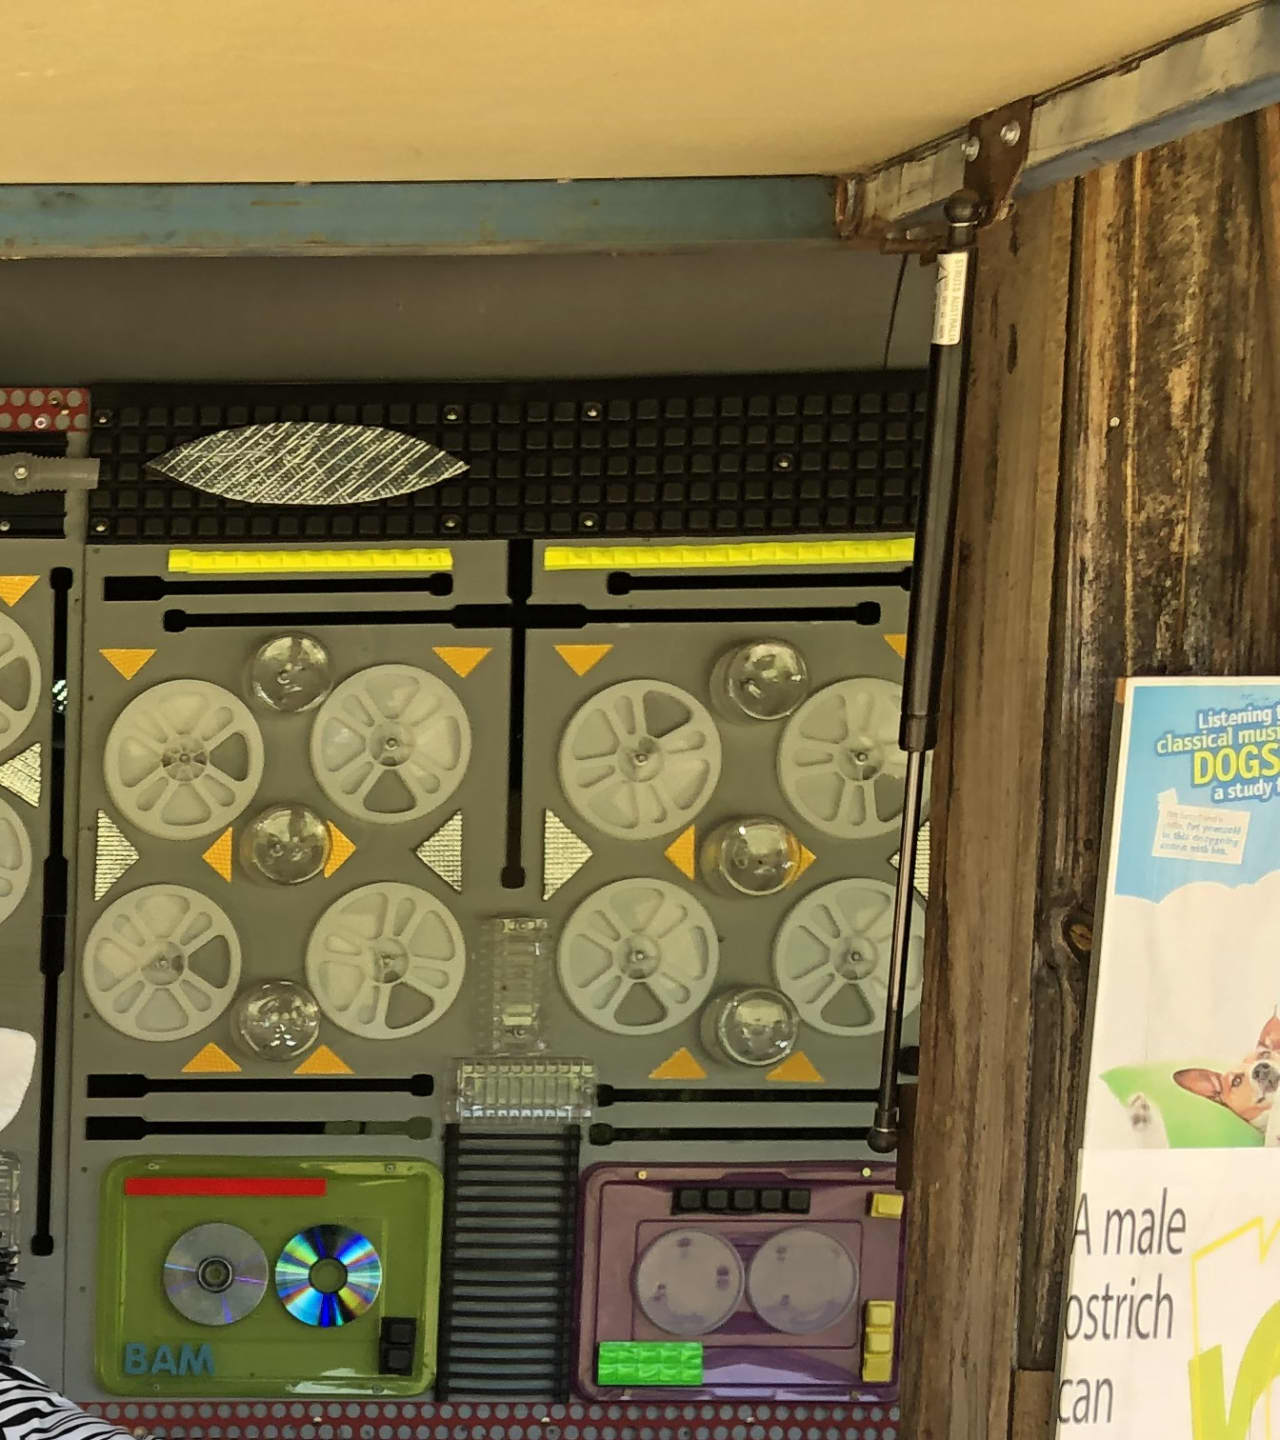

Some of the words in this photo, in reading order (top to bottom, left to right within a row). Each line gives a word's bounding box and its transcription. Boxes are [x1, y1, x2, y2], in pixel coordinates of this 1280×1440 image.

[1198, 706, 1272, 729] Listening
[1157, 727, 1233, 754] classical
[1193, 742, 1280, 785] DOGS
[1214, 787, 1224, 800] a
[1228, 779, 1273, 799] study
[1072, 1192, 1091, 1256] A
[1103, 1187, 1186, 1256] male
[1065, 1273, 1174, 1340] ostrich
[122, 1341, 215, 1377] BAM
[1057, 1376, 1114, 1425] can
